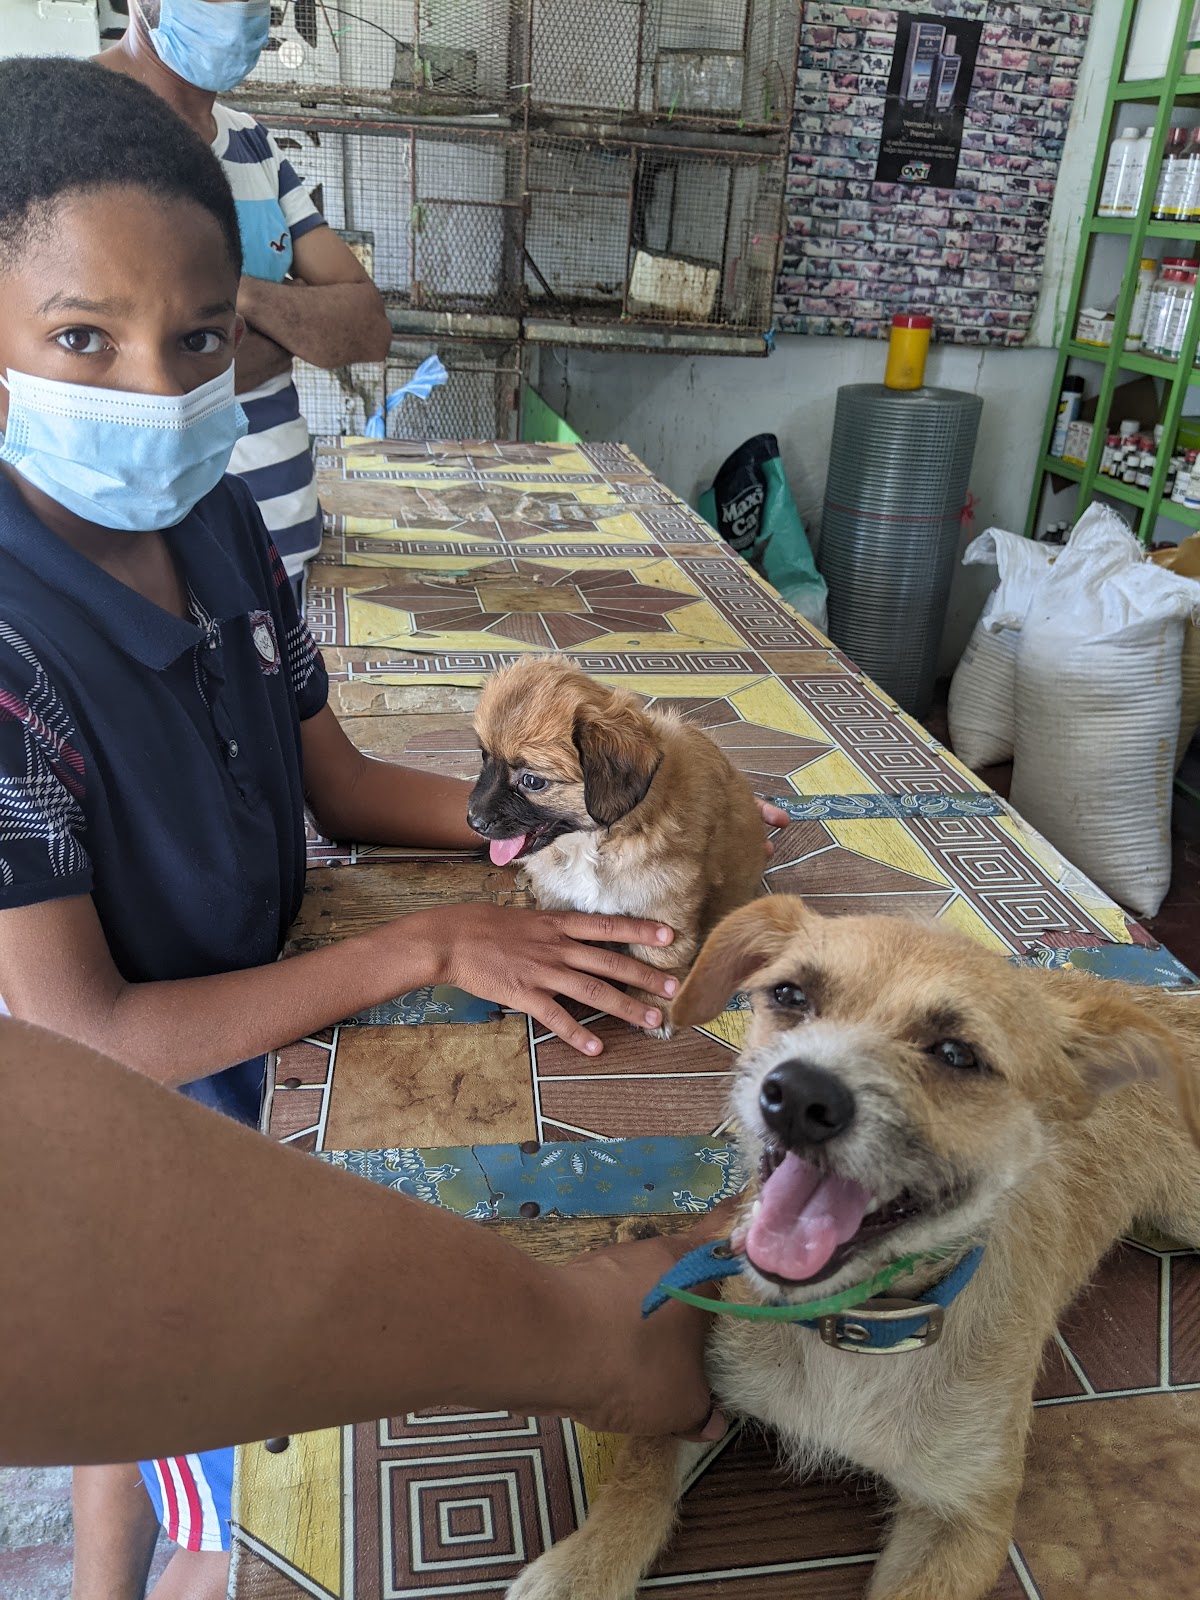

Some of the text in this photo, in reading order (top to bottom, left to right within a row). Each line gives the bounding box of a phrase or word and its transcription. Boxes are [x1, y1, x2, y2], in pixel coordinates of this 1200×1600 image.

[903, 119, 943, 131] Vermectin LA
[909, 129, 936, 139] Premium
[722, 488, 764, 523] Maxi
